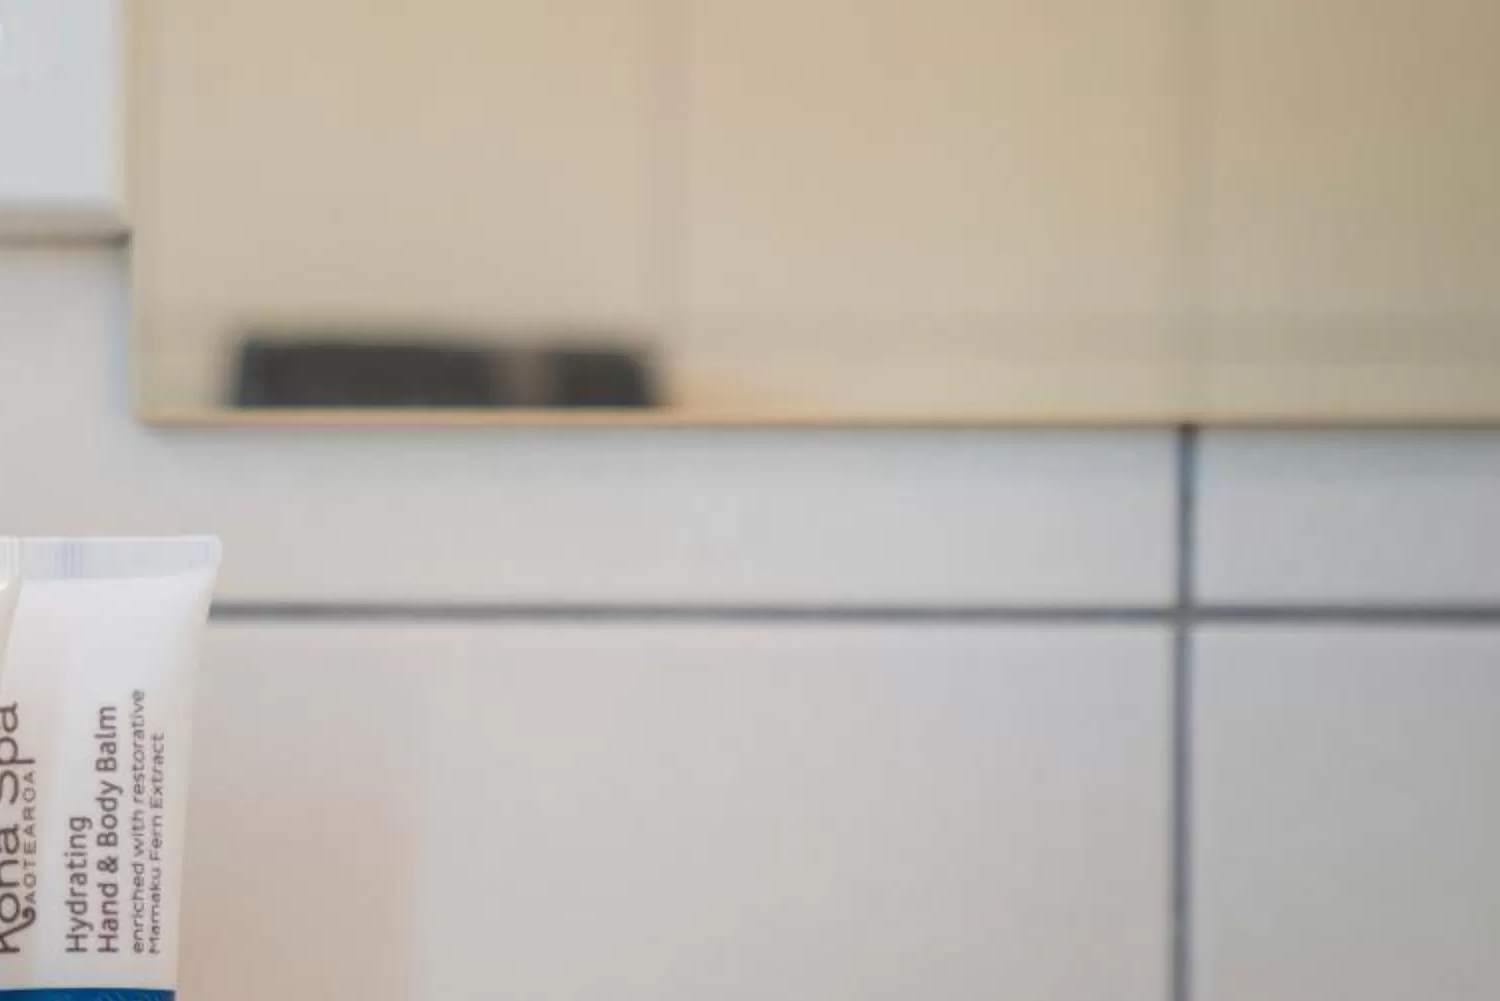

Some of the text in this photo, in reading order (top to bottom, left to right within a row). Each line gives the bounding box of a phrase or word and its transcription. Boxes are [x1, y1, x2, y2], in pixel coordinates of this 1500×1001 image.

[22, 771, 37, 904] AOTEAROA
[64, 816, 94, 954] Hydrating
[94, 706, 124, 954] Hand & Body Balm
[131, 690, 146, 955] enriched with restorative
[148, 732, 165, 956] Mamaku Fern Extract
